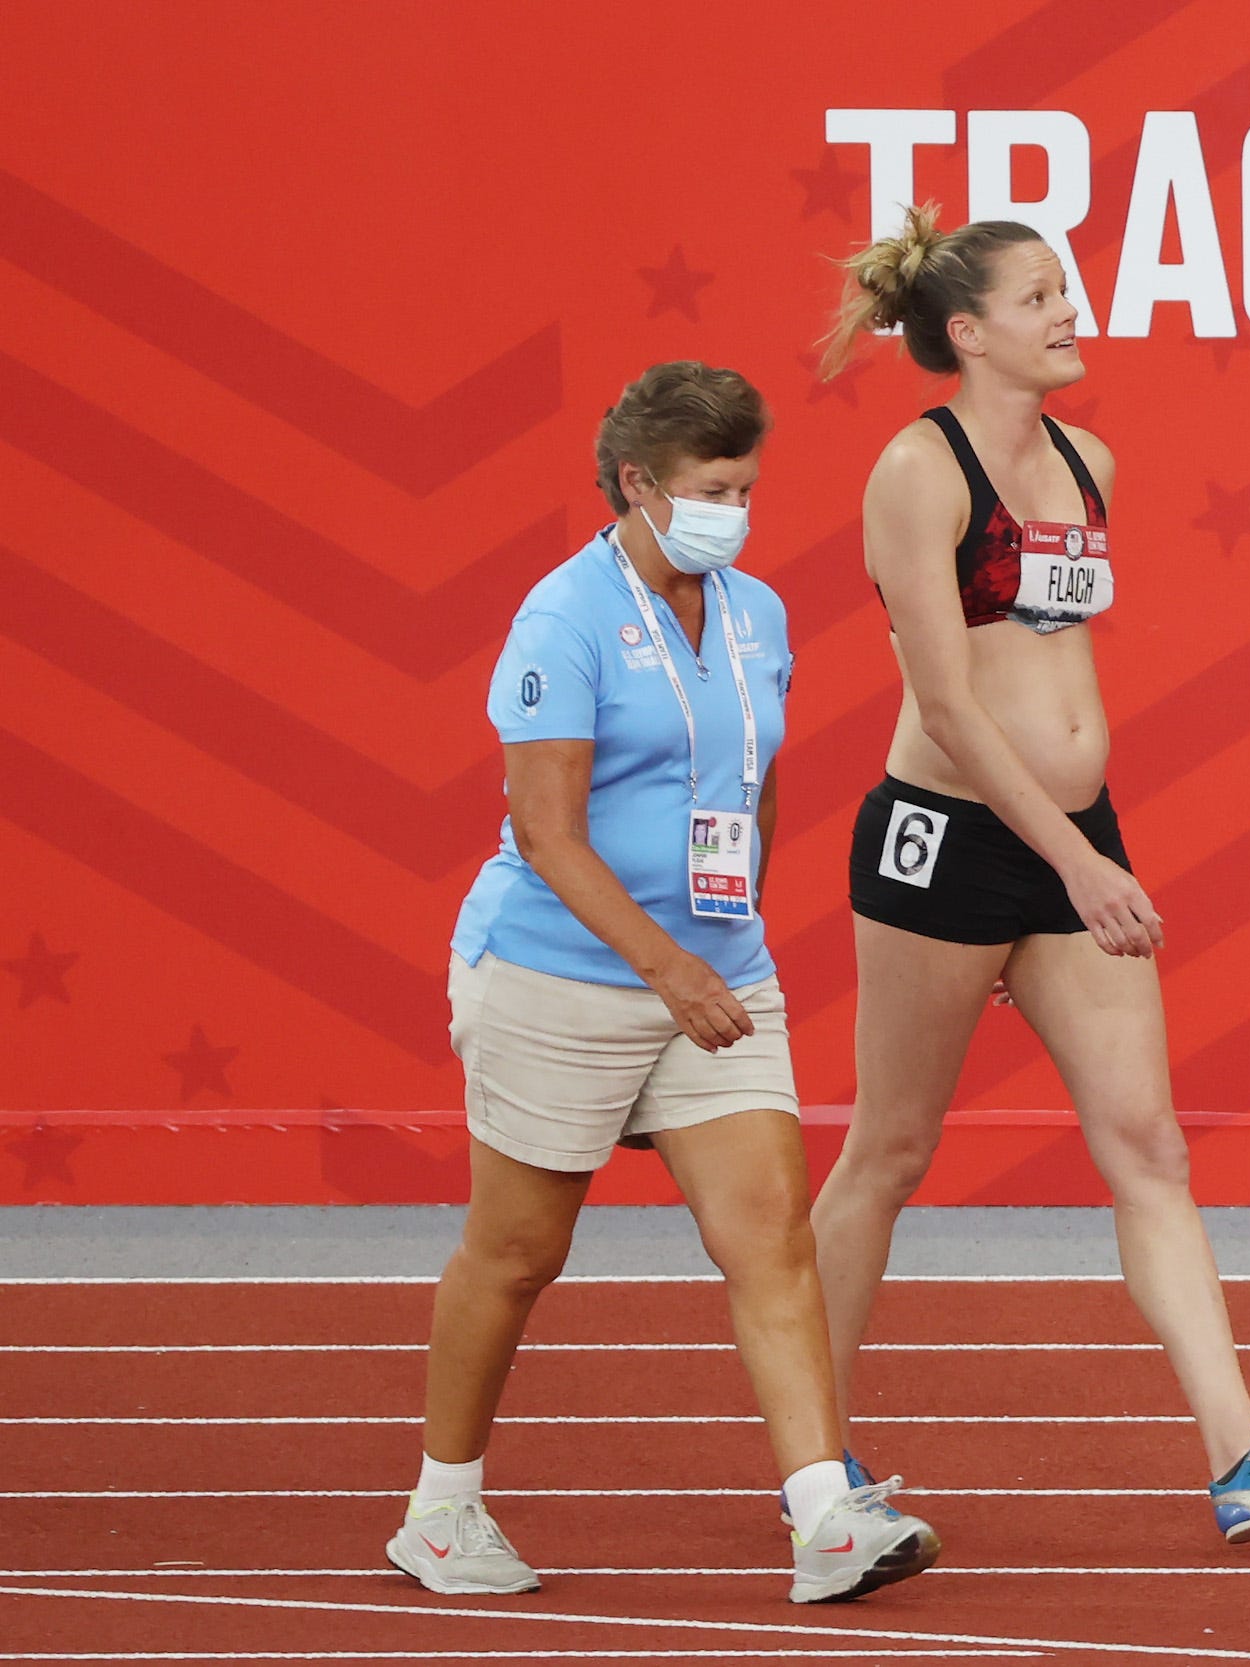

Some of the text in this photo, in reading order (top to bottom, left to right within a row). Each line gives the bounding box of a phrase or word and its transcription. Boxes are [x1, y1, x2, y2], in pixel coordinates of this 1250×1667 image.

[1048, 565, 1095, 604] FLACH
[746, 738, 755, 771] TEAM USA
[893, 812, 934, 876] 6
